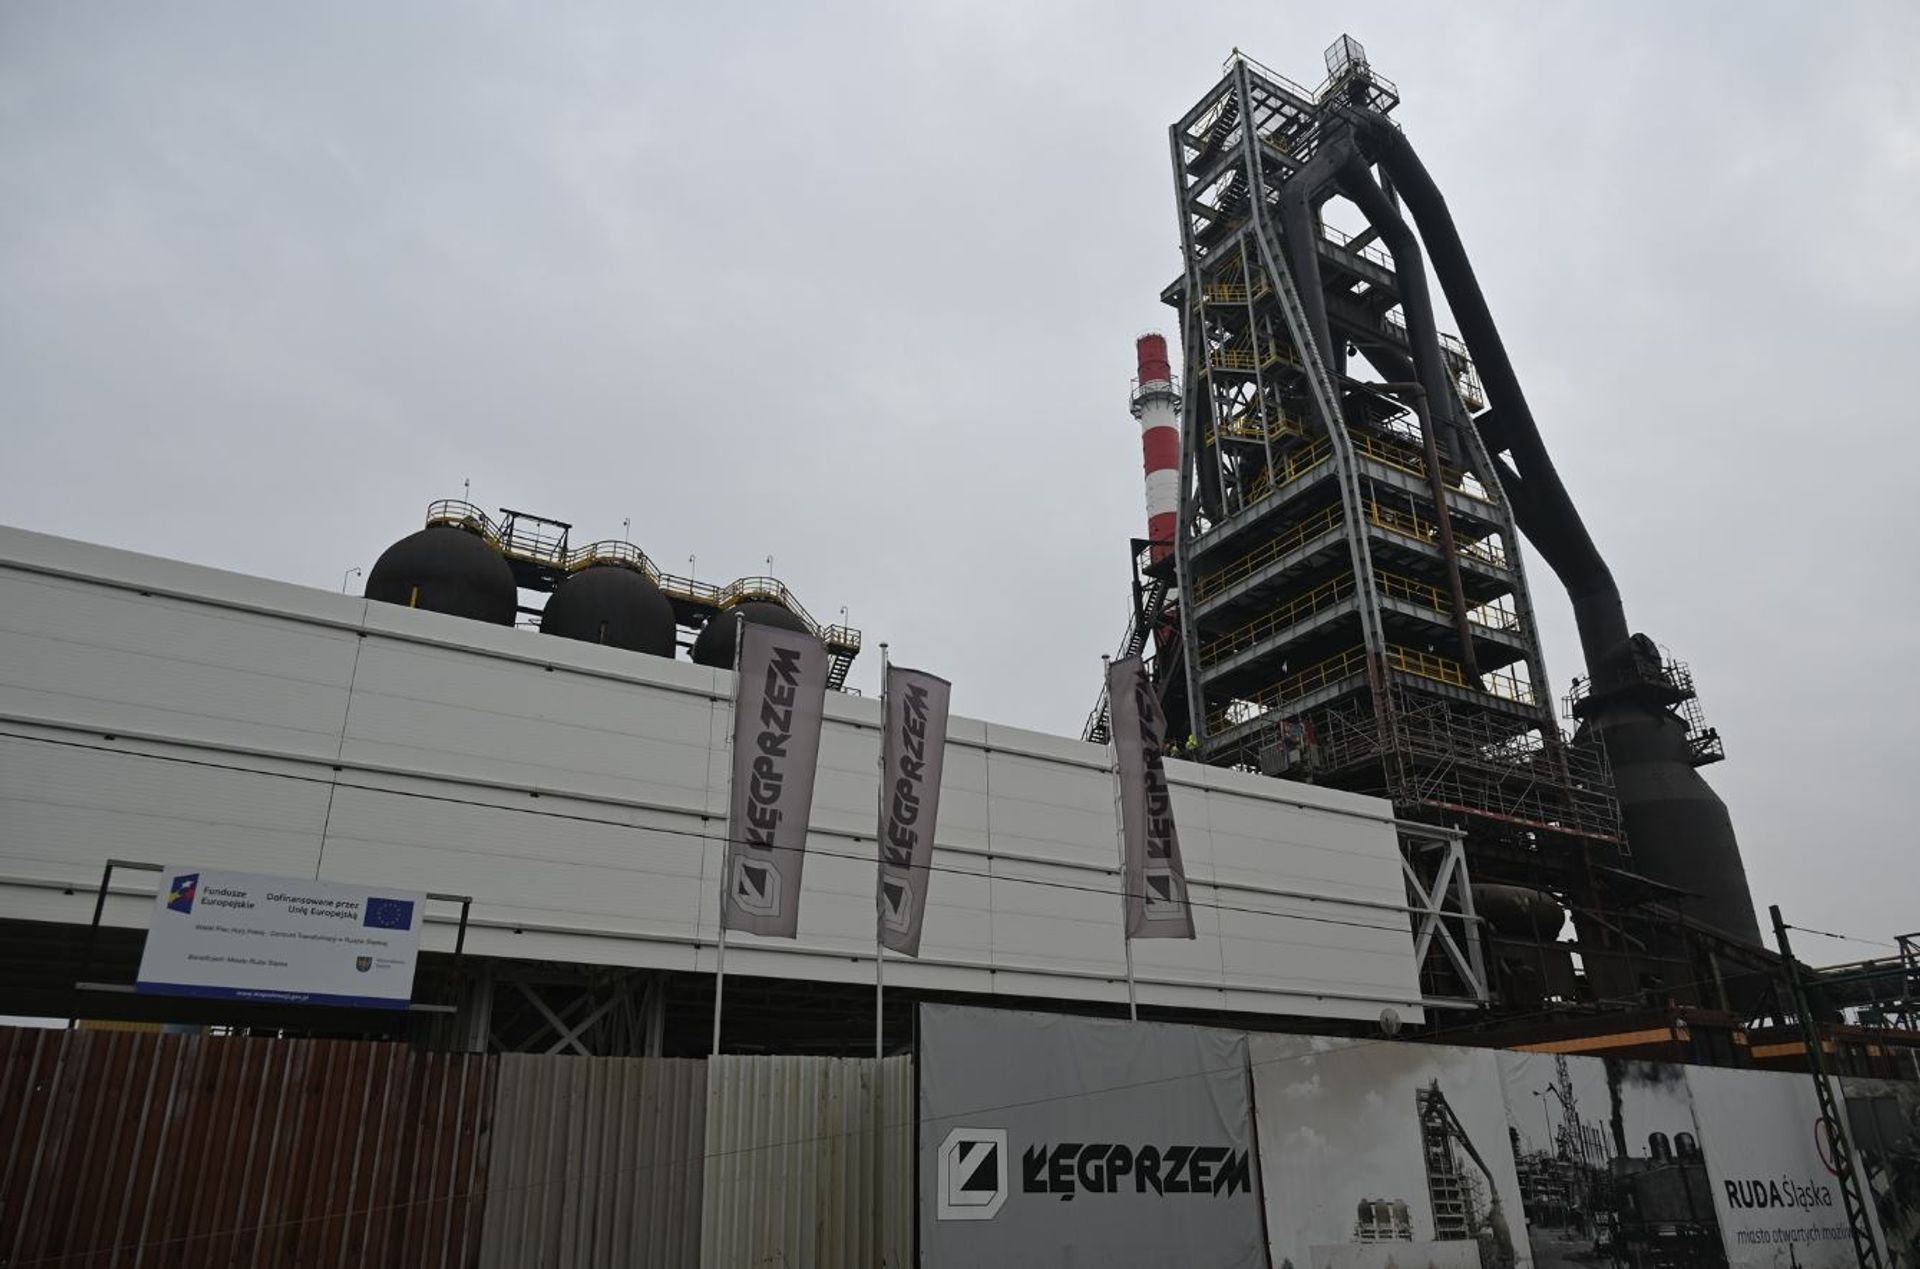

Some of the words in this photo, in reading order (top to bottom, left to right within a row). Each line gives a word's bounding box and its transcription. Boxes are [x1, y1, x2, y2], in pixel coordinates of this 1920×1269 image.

[746, 647, 801, 851] ŁĘGPRZEM
[884, 682, 929, 870] ŁĘGPRZEM
[200, 897, 256, 910] Europejskie
[203, 887, 248, 898] Fundusze
[266, 893, 334, 906] Dofinansowane
[335, 898, 361, 909] przez
[1022, 1142, 1252, 1202] ŁĘGPRZEM
[1724, 1180, 1785, 1208] RUDA
[1782, 1173, 1832, 1212] Śląska
[1738, 1226, 1771, 1244] miasto
[1773, 1222, 1822, 1246] otwartych
